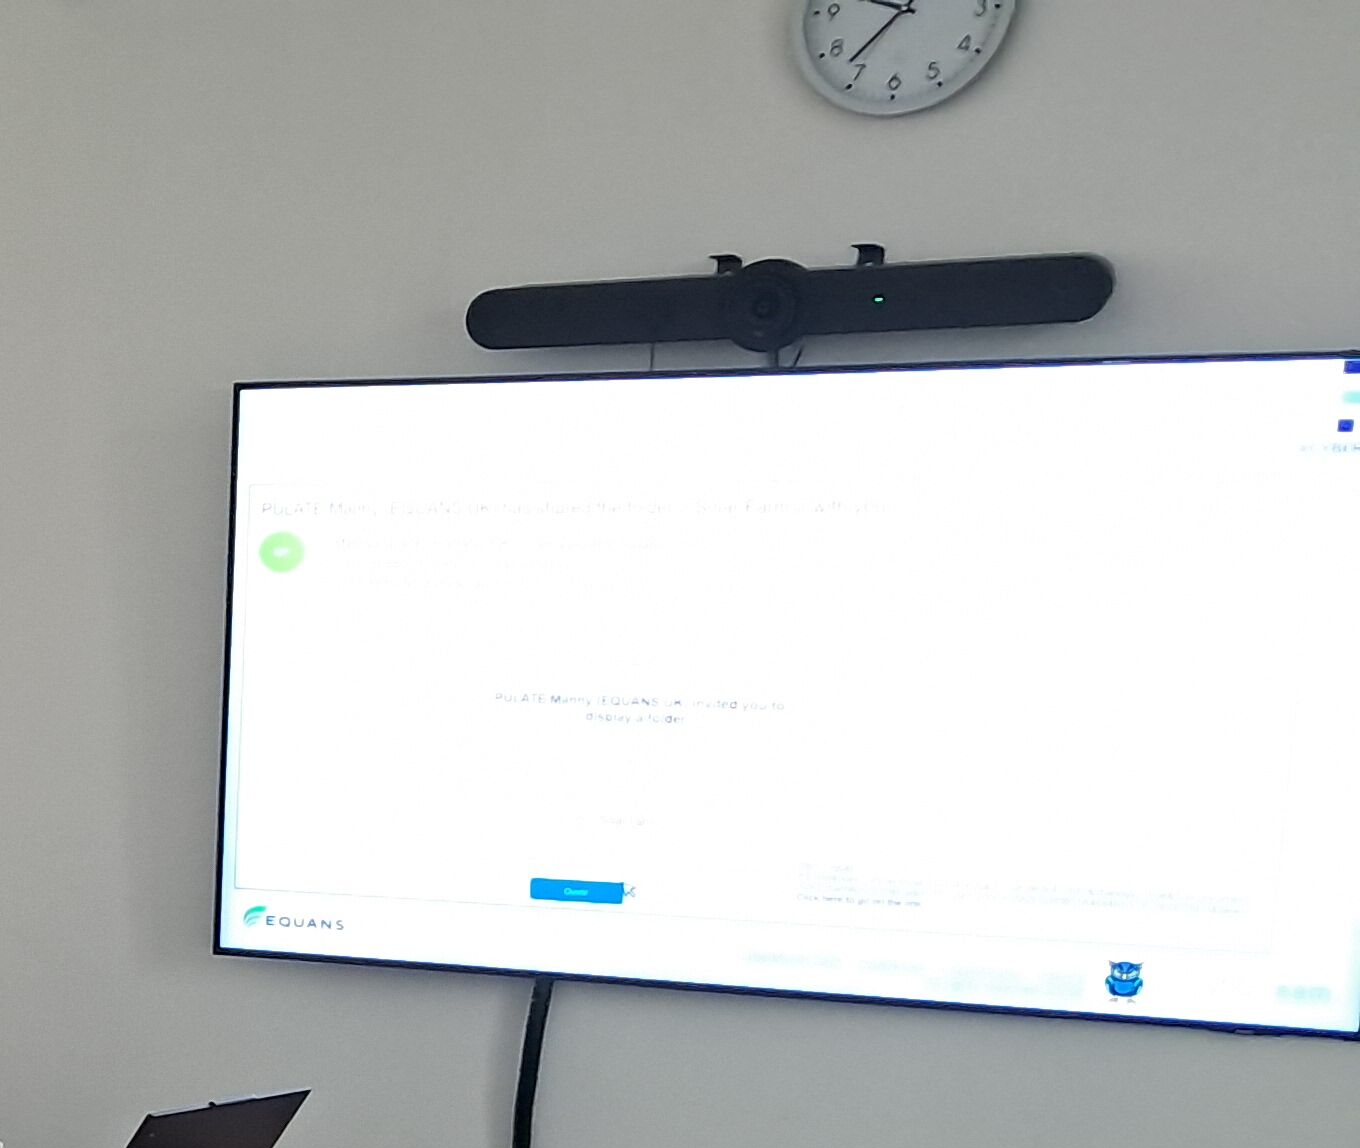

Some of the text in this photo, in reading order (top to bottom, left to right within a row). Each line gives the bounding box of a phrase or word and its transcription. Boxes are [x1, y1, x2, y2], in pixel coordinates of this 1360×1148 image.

[827, 3, 841, 21] 9
[830, 38, 844, 58] 8
[956, 34, 971, 52] 4
[852, 63, 867, 81] 7
[926, 61, 940, 80] 5
[887, 72, 902, 91] 6
[265, 915, 345, 931] EQUANS
